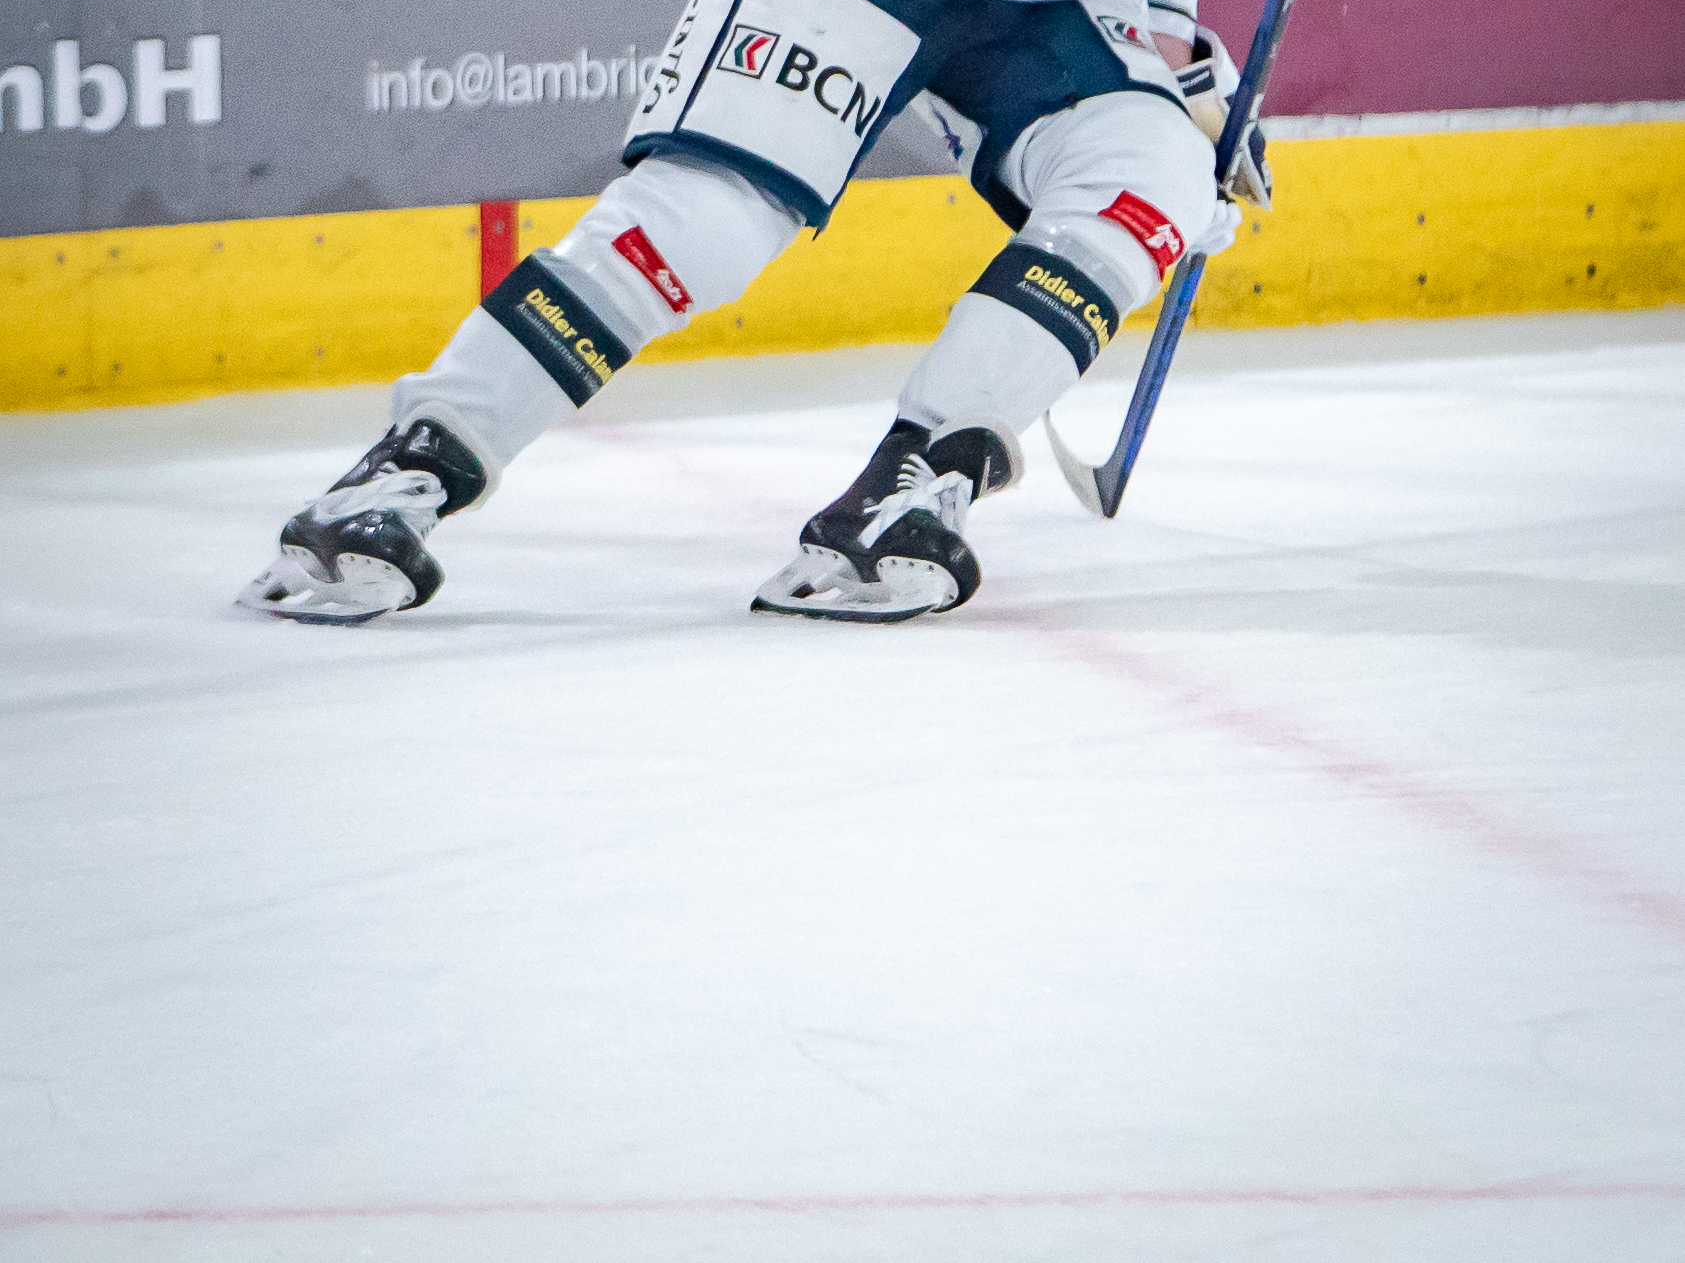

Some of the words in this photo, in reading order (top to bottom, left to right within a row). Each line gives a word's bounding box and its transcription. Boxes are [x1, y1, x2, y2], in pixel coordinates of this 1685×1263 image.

[776, 42, 880, 138] BCN
[1025, 265, 1085, 308] Didier
[525, 287, 578, 339] Didier
